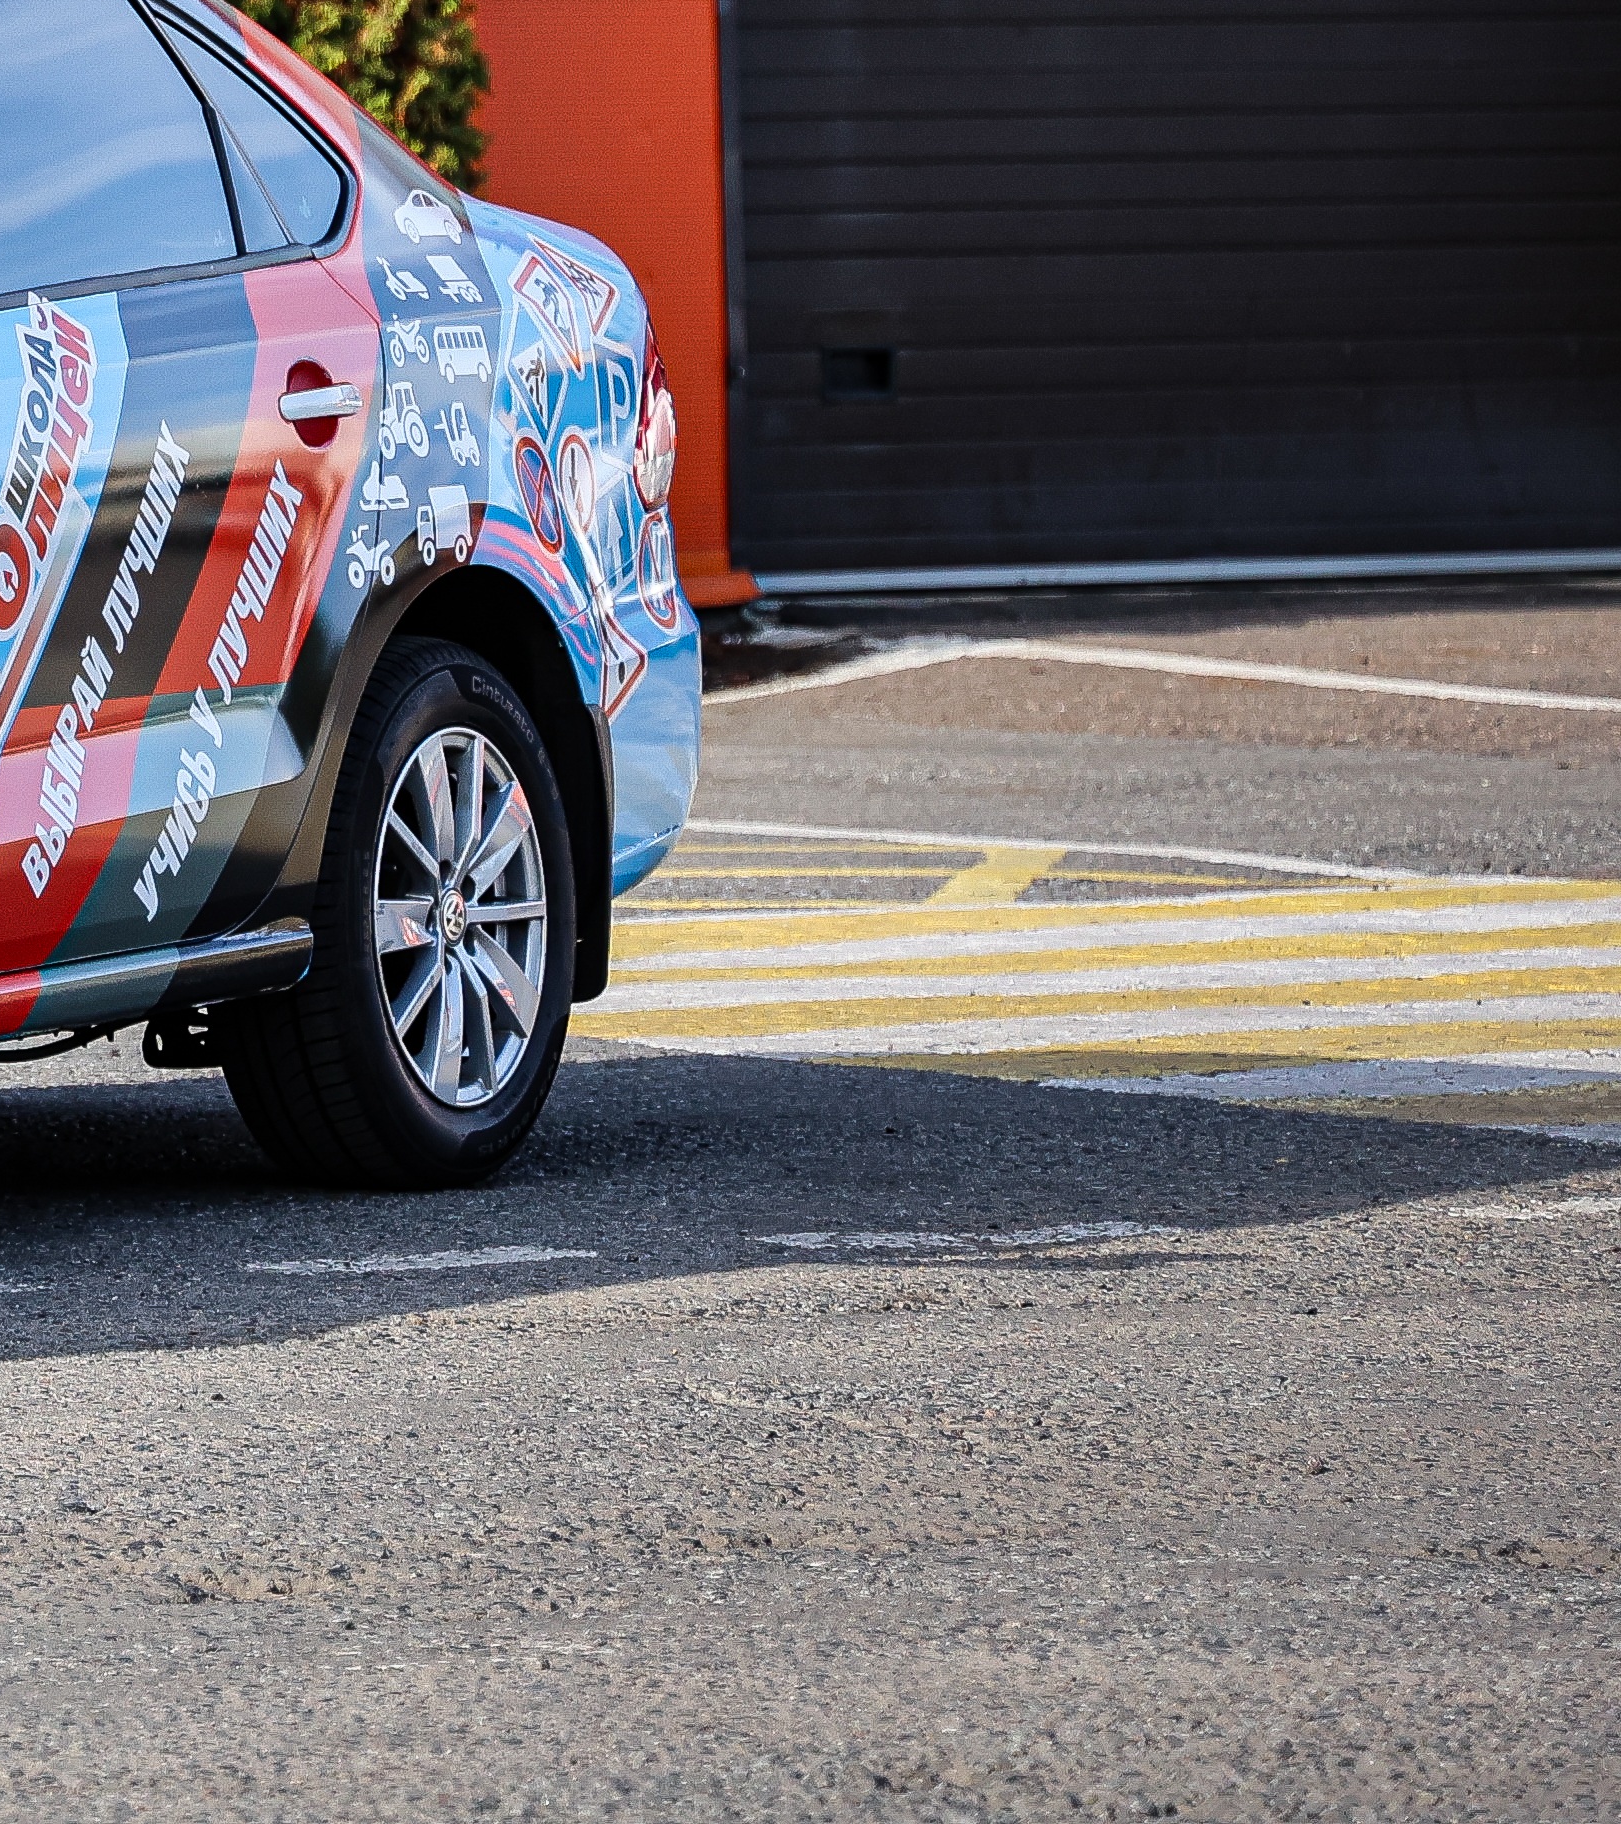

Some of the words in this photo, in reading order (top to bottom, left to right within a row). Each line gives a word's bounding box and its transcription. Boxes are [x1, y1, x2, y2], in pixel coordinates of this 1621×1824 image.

[5, 333, 56, 523] ШКОЛА
[21, 635, 114, 900] ВЫБИРАЙ
[101, 419, 191, 655] ЛУЧШИХ
[132, 746, 217, 923] УЧИСЬ
[189, 685, 224, 750] У
[207, 458, 305, 706] ЛУЧШИХ
